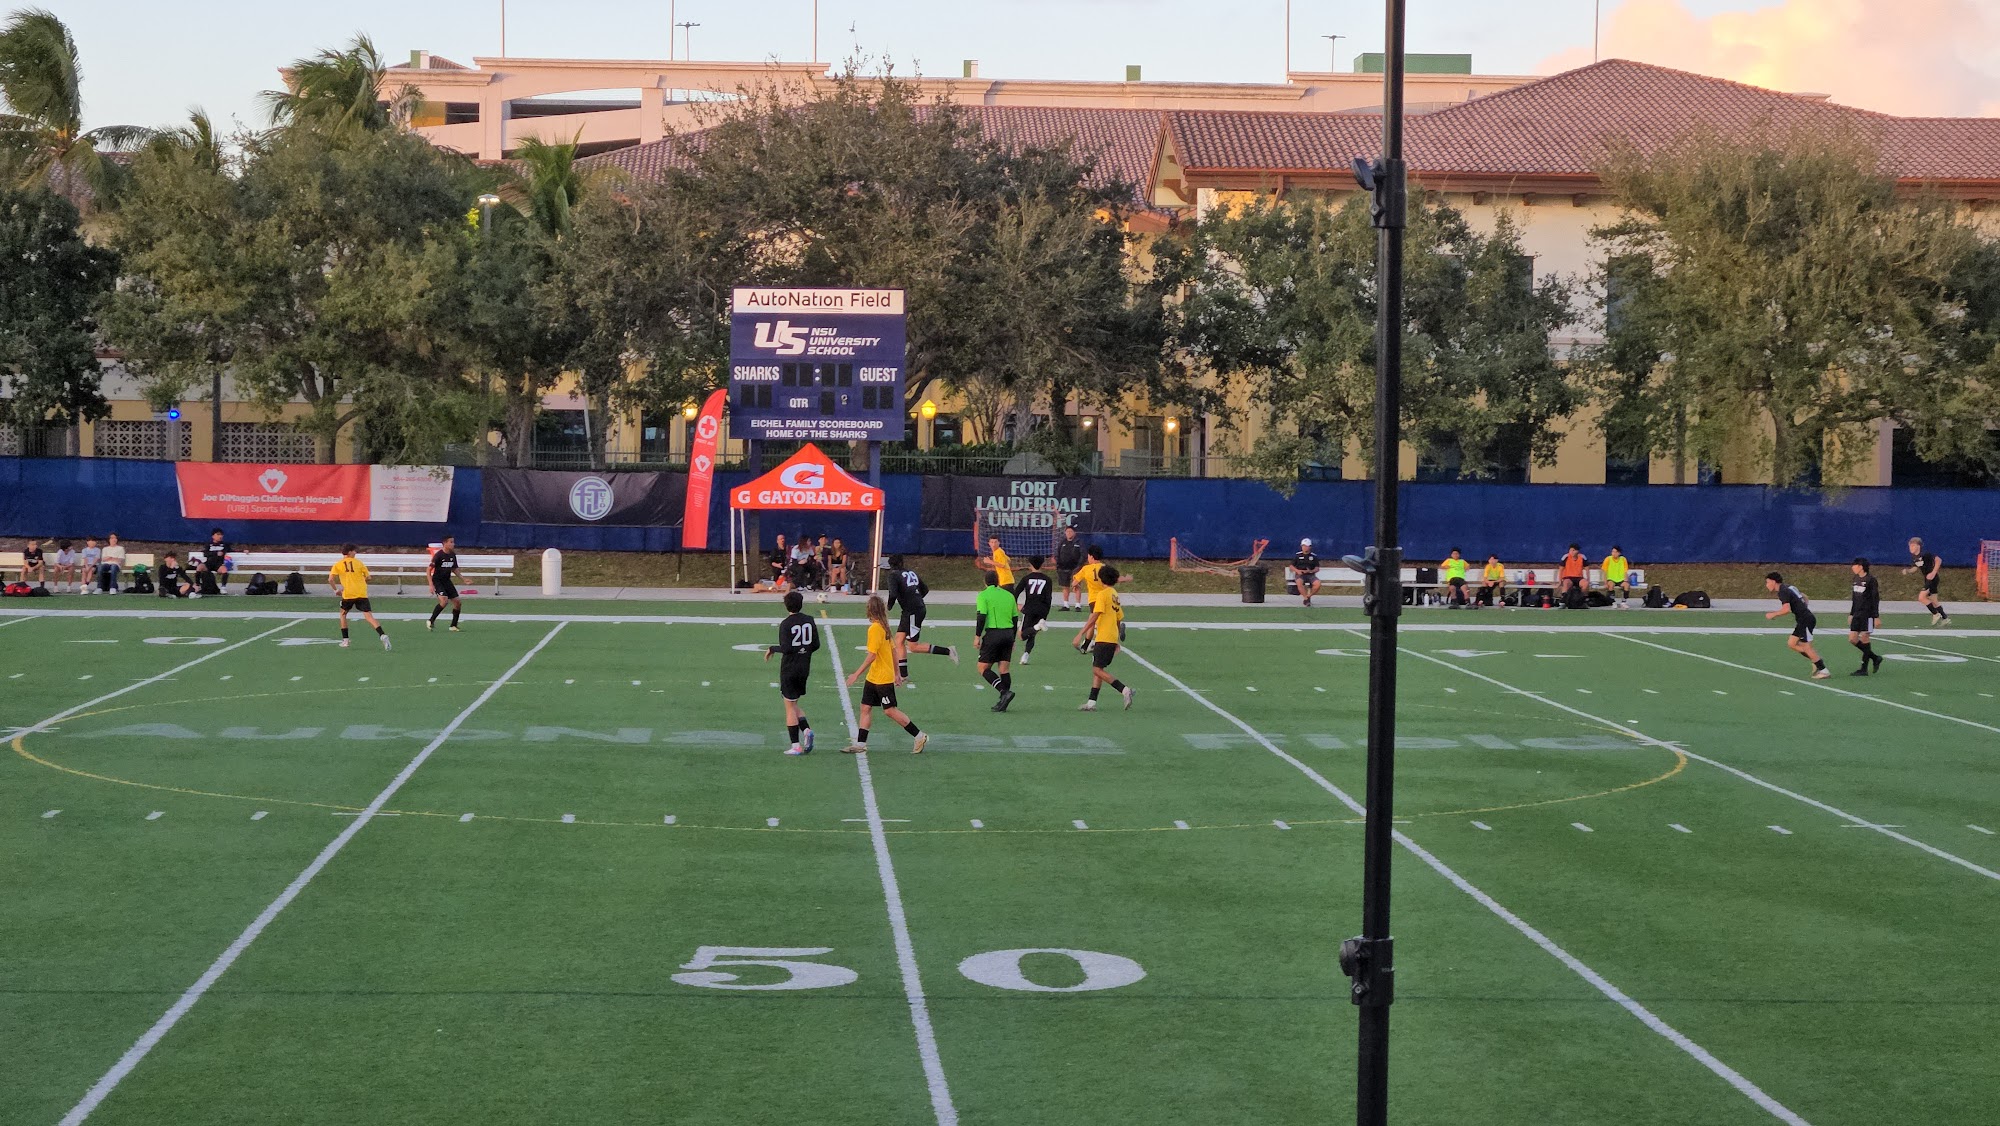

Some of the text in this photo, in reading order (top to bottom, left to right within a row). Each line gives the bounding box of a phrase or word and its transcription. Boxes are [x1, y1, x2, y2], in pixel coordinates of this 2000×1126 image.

[747, 291, 891, 307] AutoNation Field
[811, 328, 837, 336] NSU
[809, 337, 881, 346] UNIVERSITY
[807, 346, 855, 356] SCHOOL
[734, 366, 780, 381] SHARKS
[859, 367, 897, 382] GUEST
[789, 398, 809, 408] QTR
[751, 419, 883, 429] EICHEL FAMILY SCOREBOARD
[766, 429, 868, 439] HOME OF THE SHARKS
[780, 462, 825, 489] G
[1011, 480, 1057, 496] FORT
[202, 493, 343, 505] Joe DiMaggio Children's Hospital
[737, 491, 873, 506] G GATORADE G
[976, 496, 1091, 512] LAUDERDALE
[251, 504, 278, 514] Sports
[280, 505, 317, 514] Medicine
[988, 511, 1079, 528] UNITED FC
[343, 560, 355, 573] 11
[901, 570, 919, 587] 29
[1028, 578, 1047, 595] 77
[791, 622, 813, 647] 20
[881, 696, 891, 705] 41
